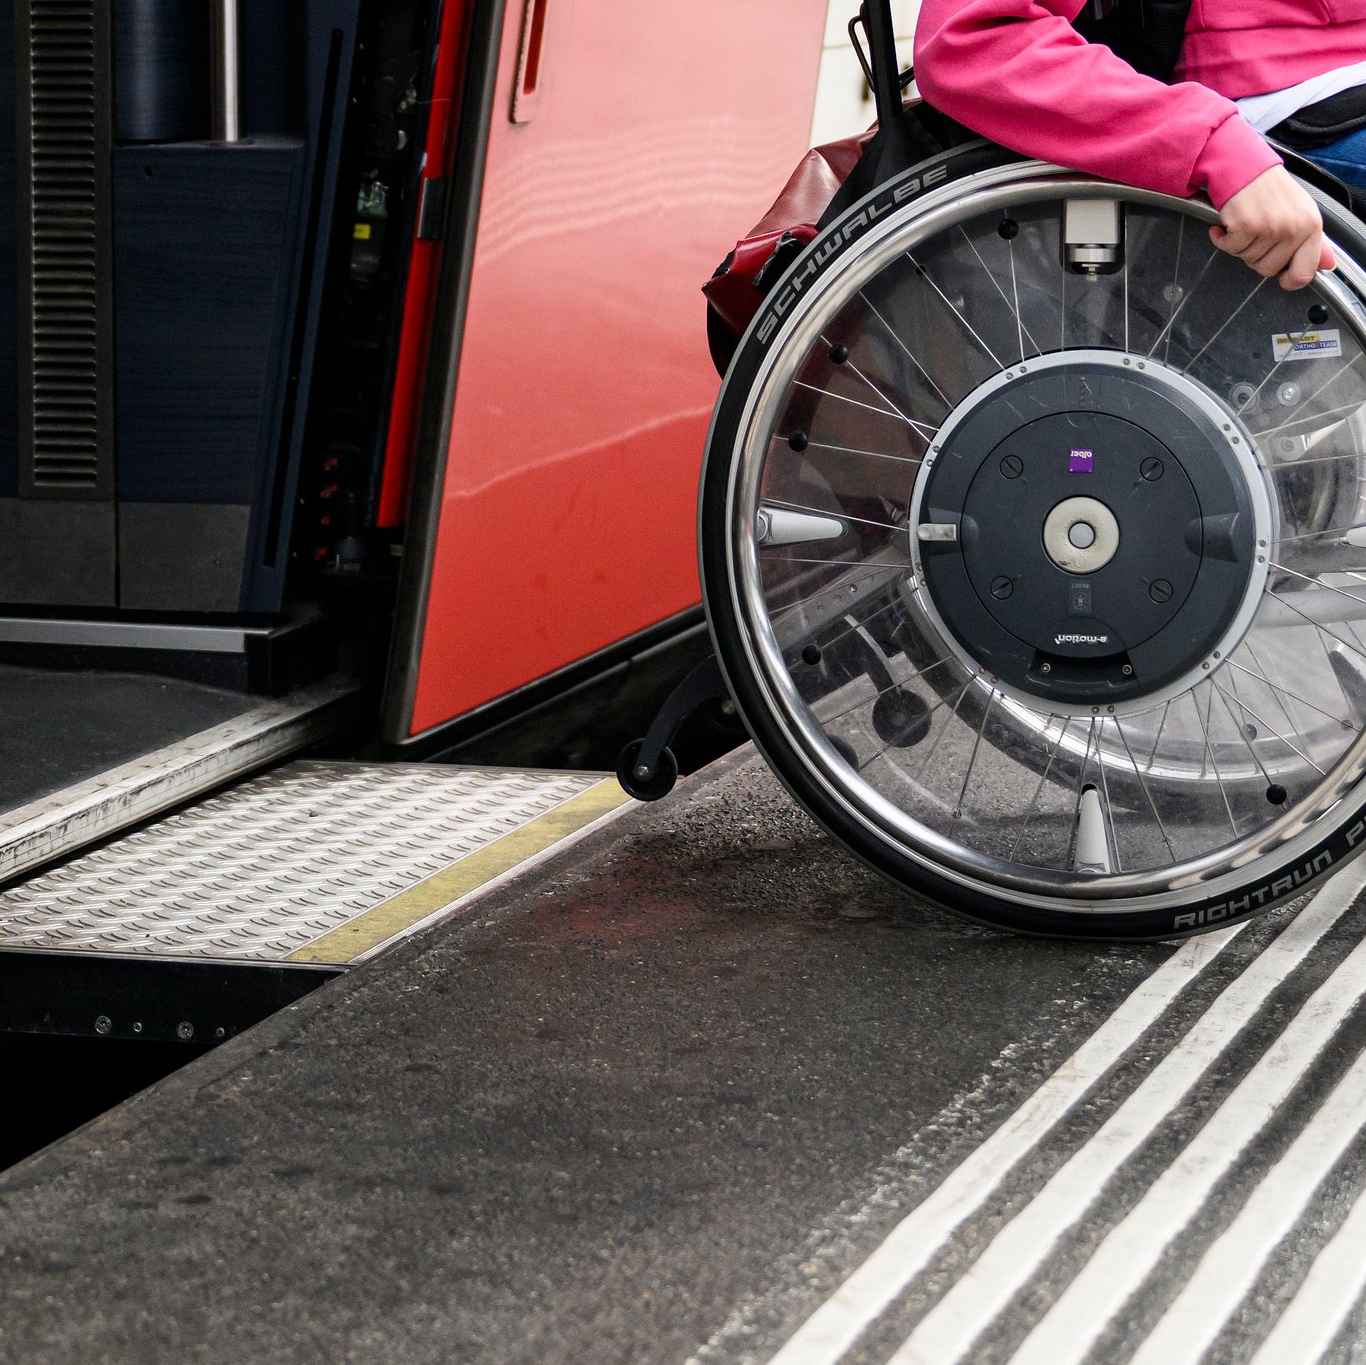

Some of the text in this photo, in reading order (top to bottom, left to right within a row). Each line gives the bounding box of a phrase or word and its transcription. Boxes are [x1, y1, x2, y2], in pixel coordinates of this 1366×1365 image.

[756, 164, 948, 344] SCHWALBE
[1070, 450, 1092, 458] alber
[1055, 634, 1108, 644] e-motion
[1174, 850, 1332, 929] RIGHTRUN
